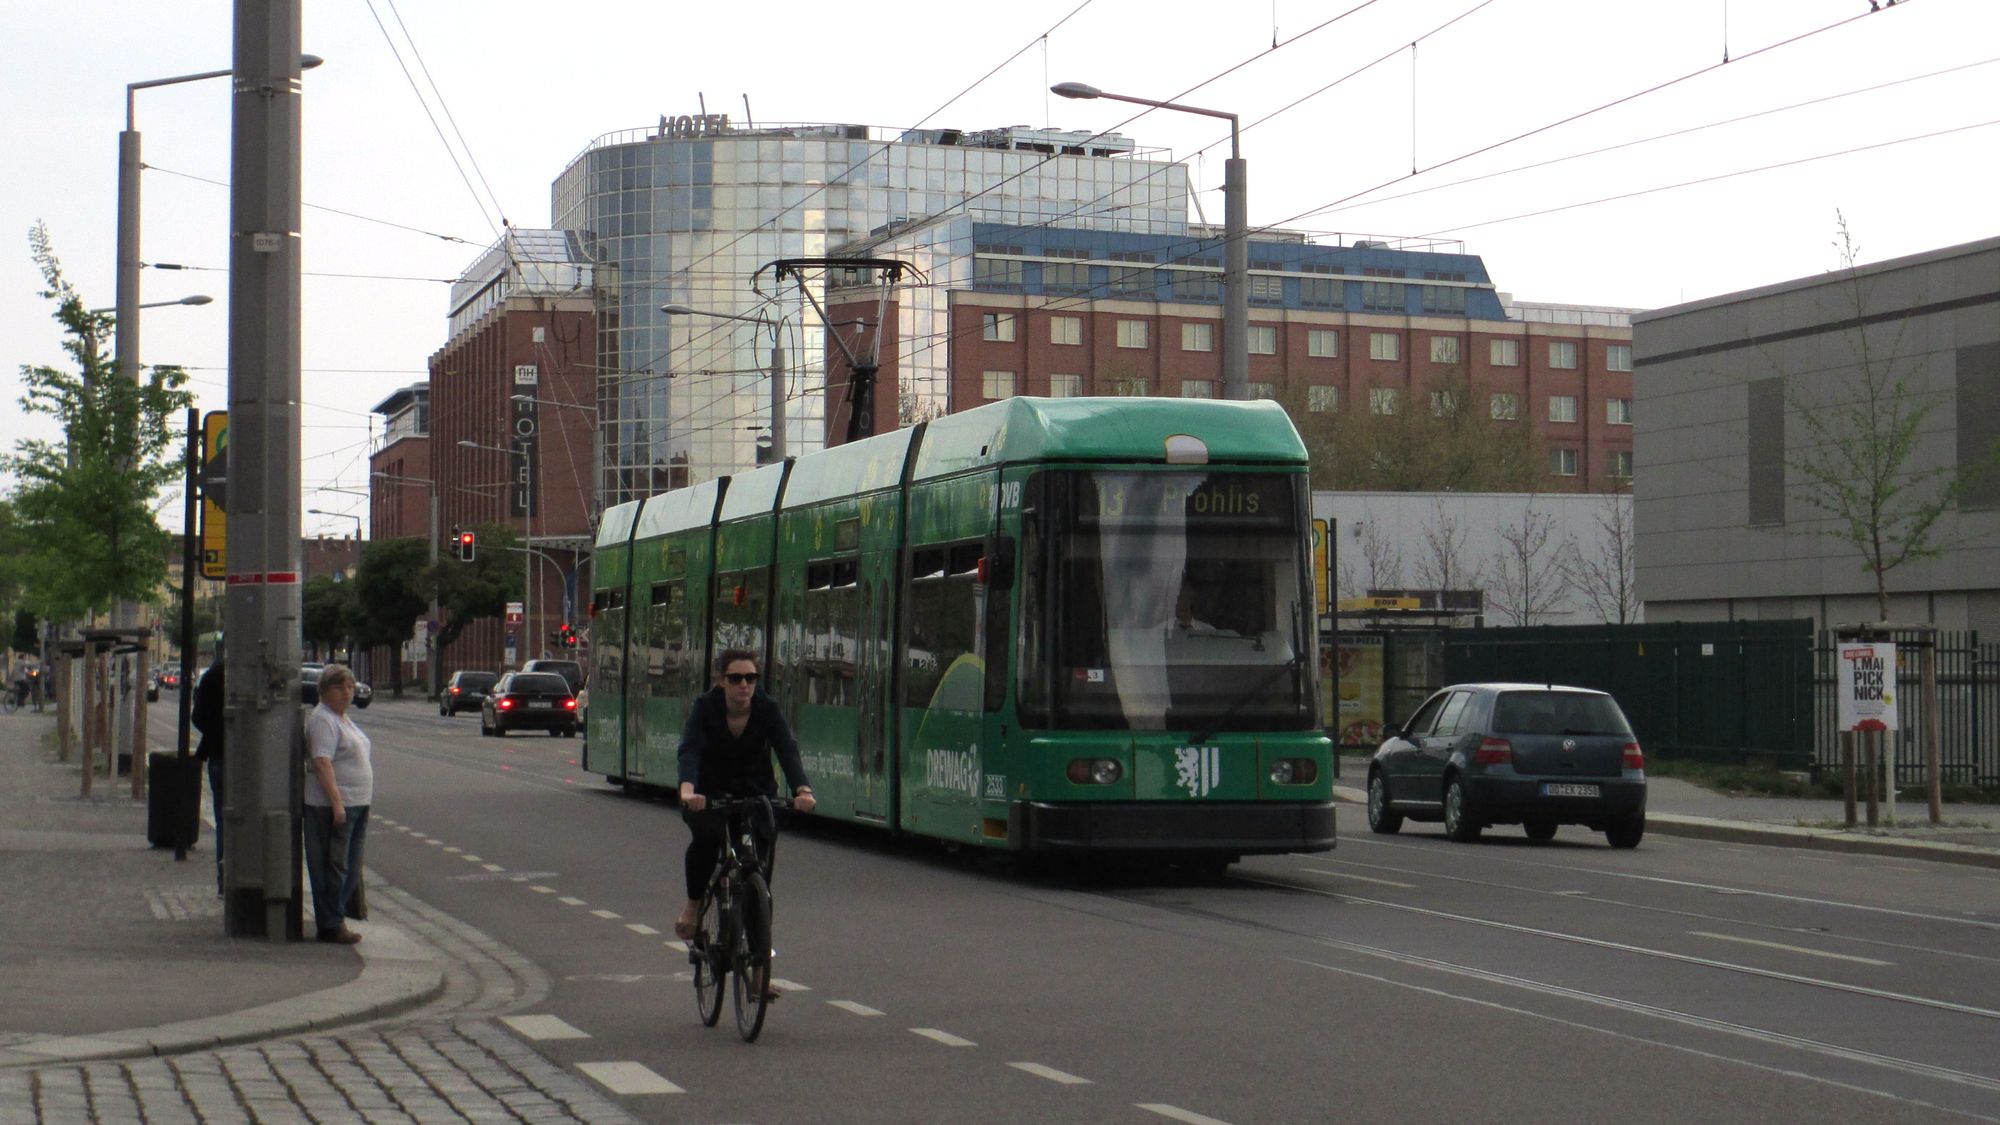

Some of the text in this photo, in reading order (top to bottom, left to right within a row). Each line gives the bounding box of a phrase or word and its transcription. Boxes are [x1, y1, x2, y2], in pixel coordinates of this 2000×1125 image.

[658, 113, 734, 137] HOTEL
[1163, 483, 1260, 513] Prohlis
[1854, 671, 1884, 685] PICK
[1854, 686, 1884, 700] NICK
[927, 749, 967, 791] DREWAG
